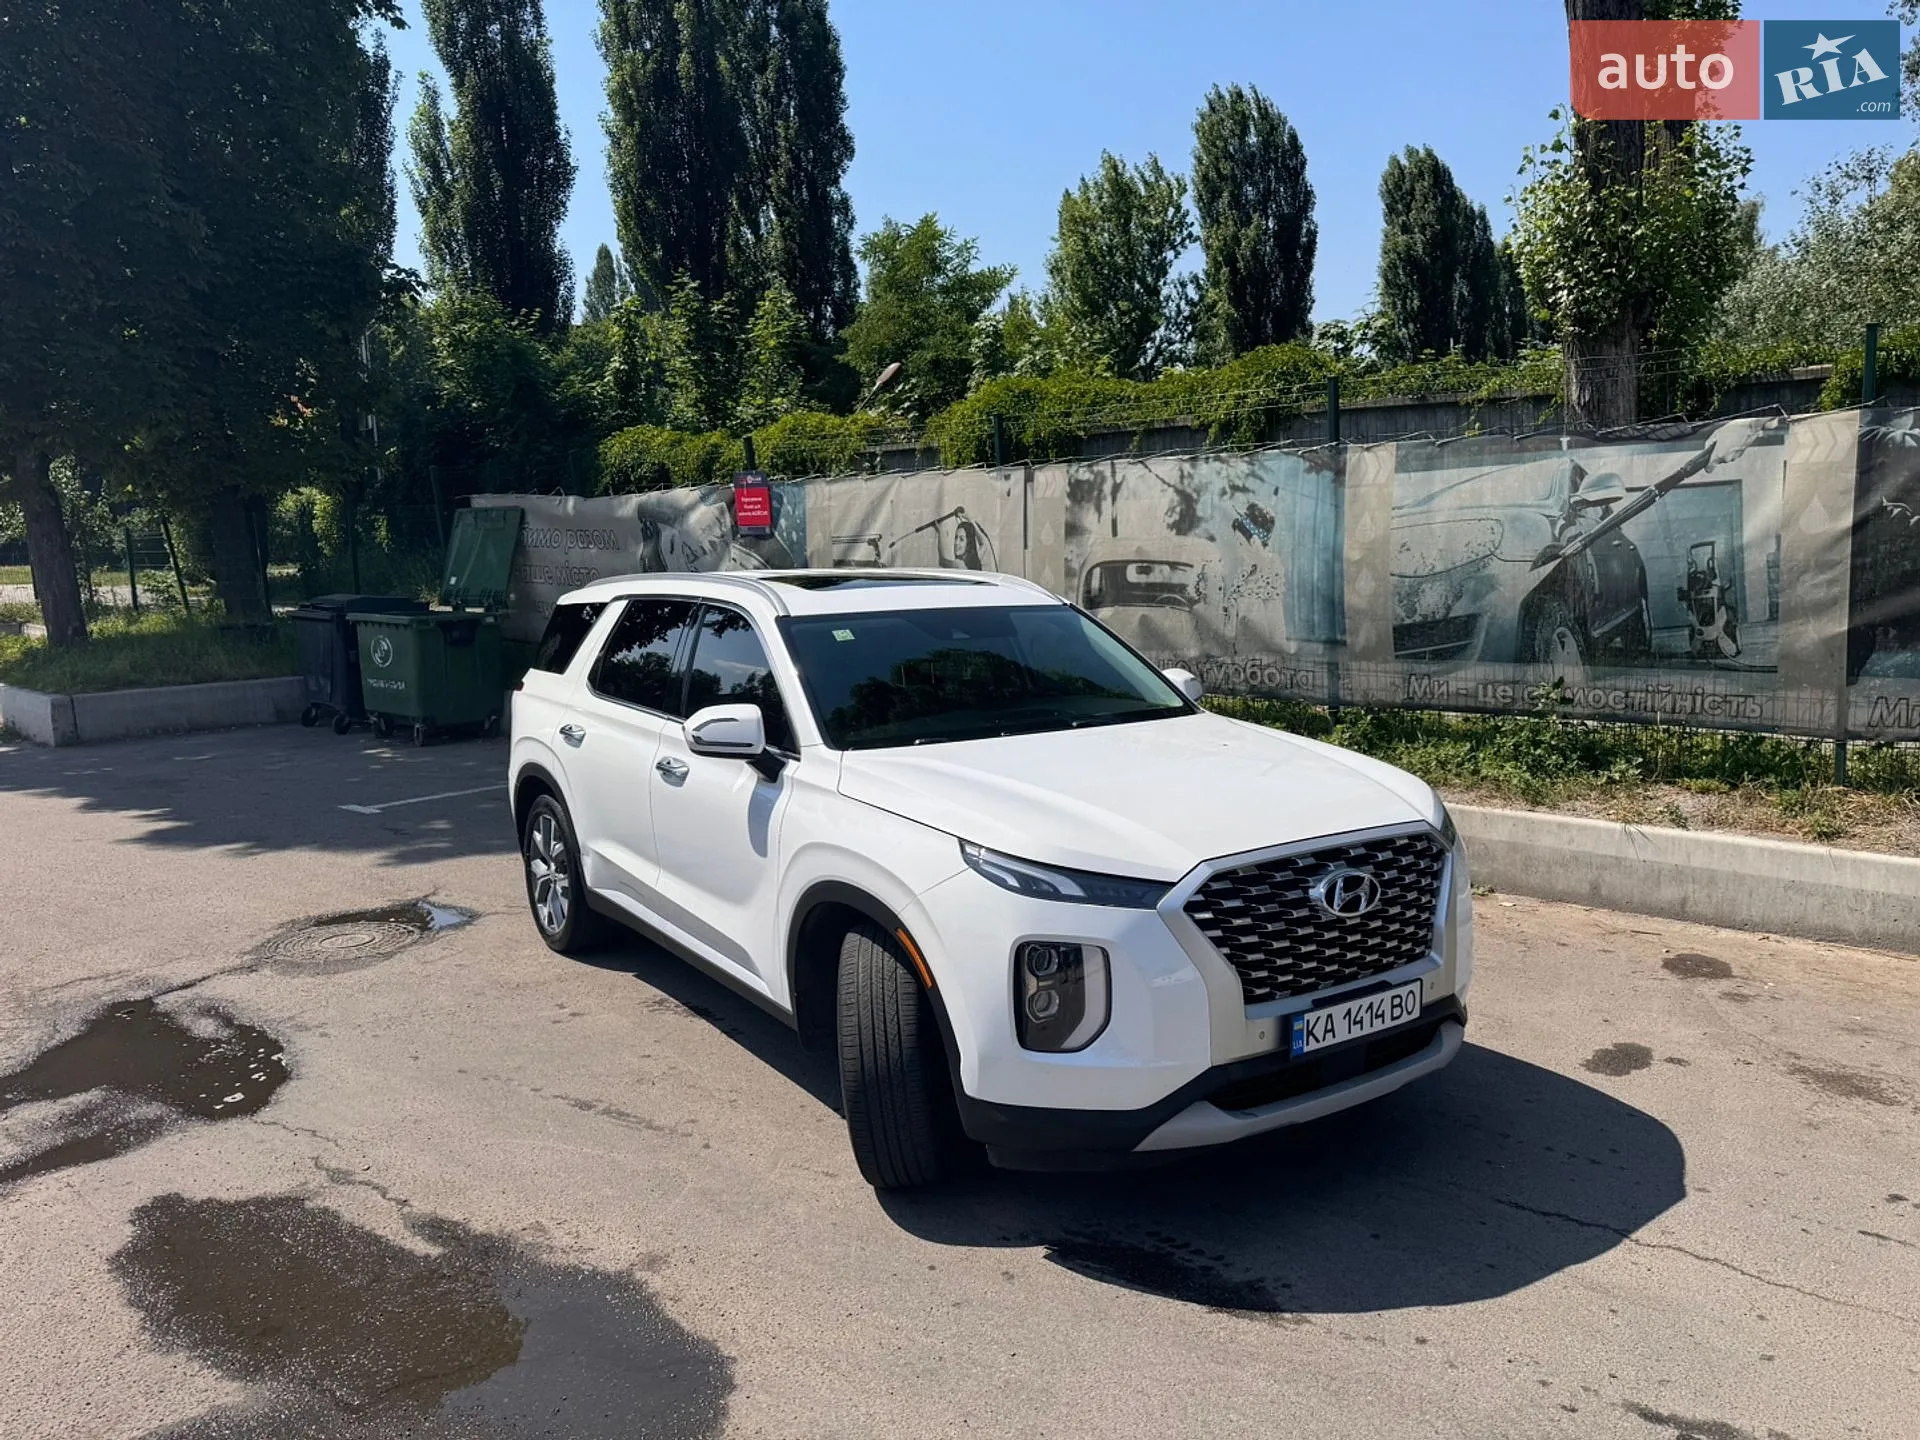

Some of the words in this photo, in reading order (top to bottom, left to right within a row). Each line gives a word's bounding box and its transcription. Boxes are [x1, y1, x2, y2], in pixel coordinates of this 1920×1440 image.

[565, 528, 620, 554] разом
[1201, 658, 1314, 692] турбота
[1405, 673, 1449, 700] Ми
[1478, 683, 1513, 704] це
[1521, 683, 1764, 718] смостійність
[1306, 1012, 1336, 1046] KA
[1343, 999, 1385, 1035] 1414
[1390, 989, 1416, 1022] BO
